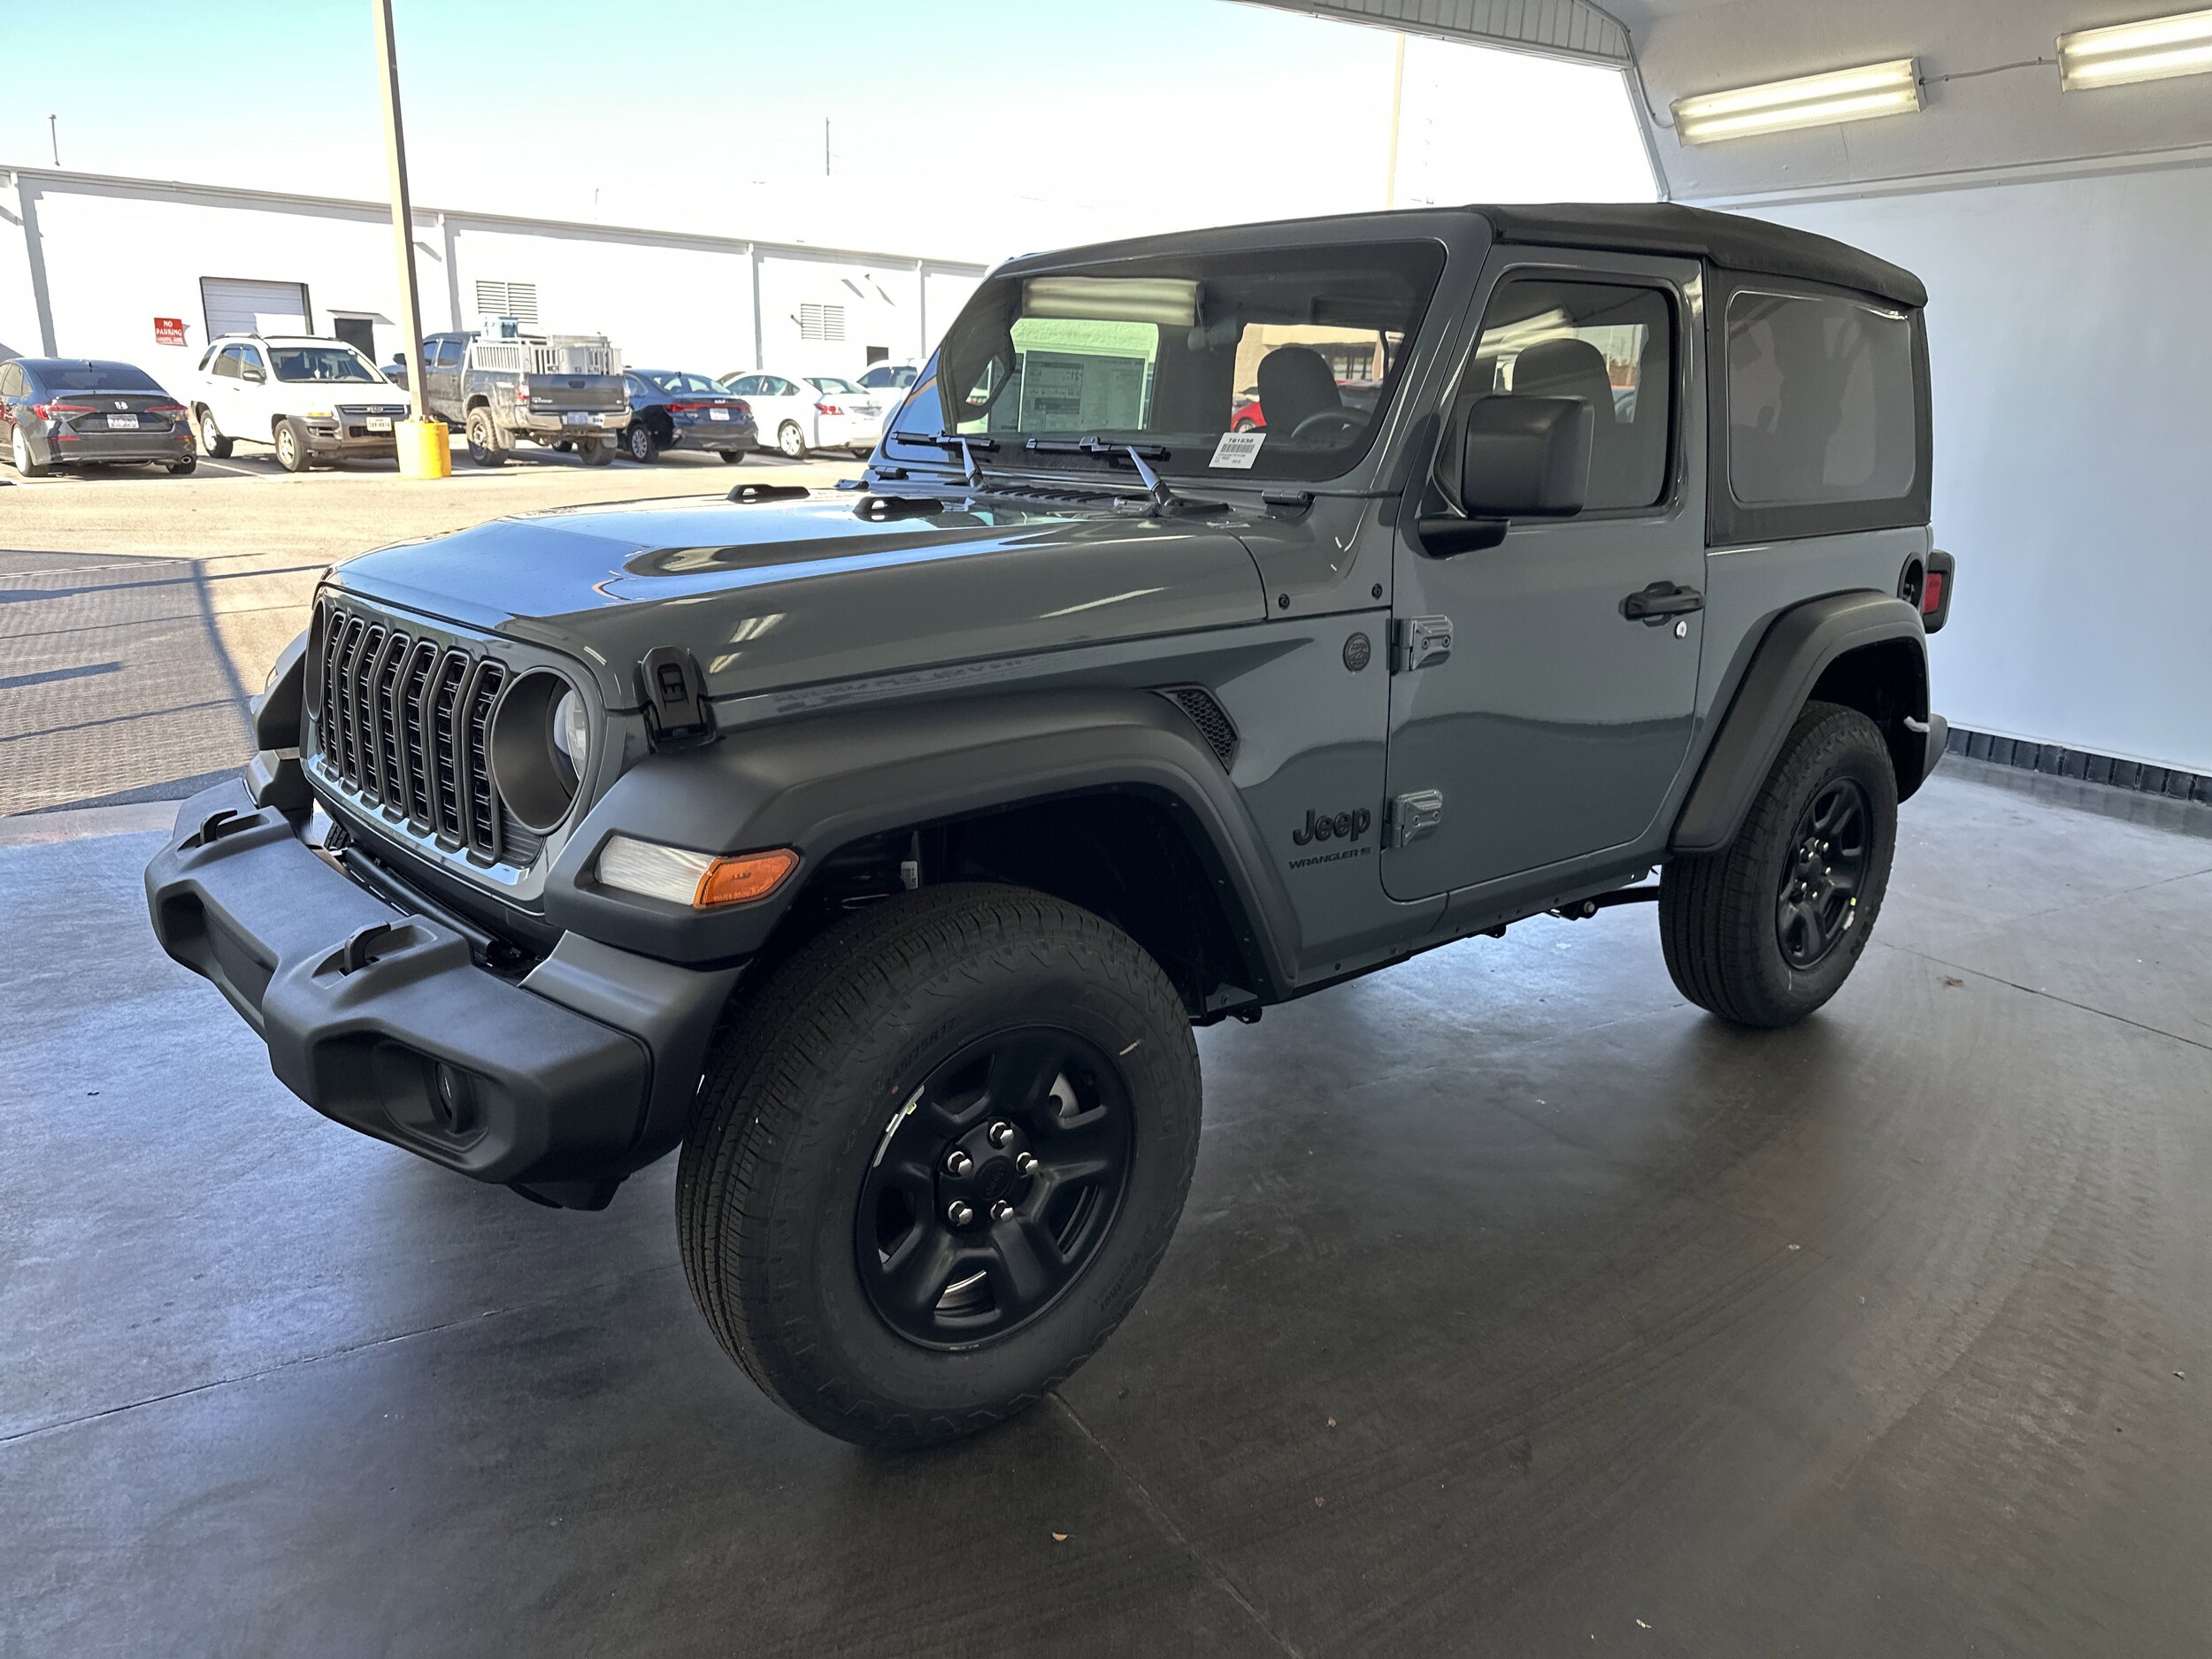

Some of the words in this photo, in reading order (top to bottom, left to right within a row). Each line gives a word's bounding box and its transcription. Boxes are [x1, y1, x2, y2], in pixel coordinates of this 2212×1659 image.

[156, 327, 182, 336] PARKING
[1293, 808, 1371, 846] Jeep
[1288, 849, 1358, 870] WRANGLER
